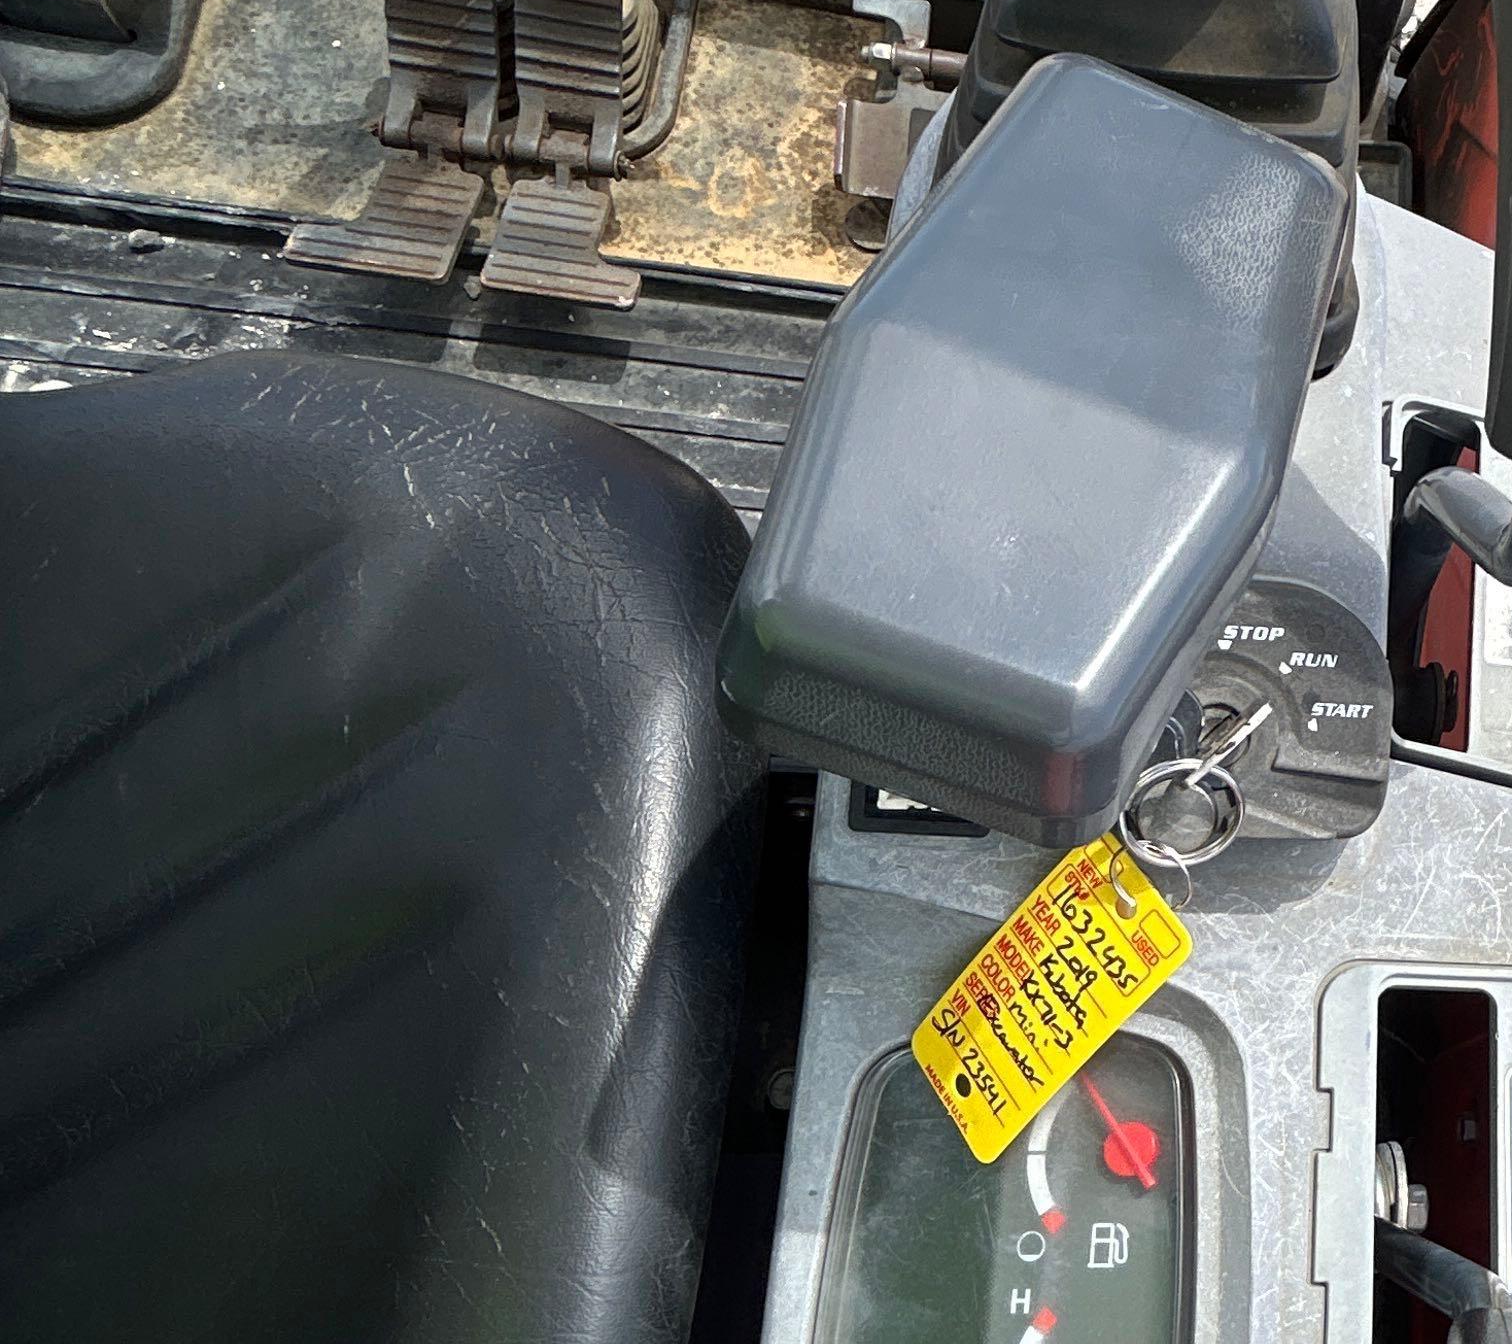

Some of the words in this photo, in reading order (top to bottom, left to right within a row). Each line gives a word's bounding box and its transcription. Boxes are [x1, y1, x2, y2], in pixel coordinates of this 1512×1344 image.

[1223, 625, 1285, 641] STOP
[1289, 652, 1338, 668] RUN
[1311, 702, 1374, 719] START
[1077, 859, 1103, 889] NEW
[1013, 914, 1045, 957] MAKE
[1032, 895, 1061, 937] YEAR
[996, 933, 1033, 982] MODEL
[1056, 936, 1098, 992] 2019
[1131, 929, 1159, 966] USED
[981, 953, 1015, 1002] COLOR
[951, 988, 972, 1017] VIN
[924, 1064, 946, 1096] MADE
[942, 1093, 953, 1106] IN
[961, 1048, 1007, 1115] 23541
[1010, 1288, 1031, 1314] H
